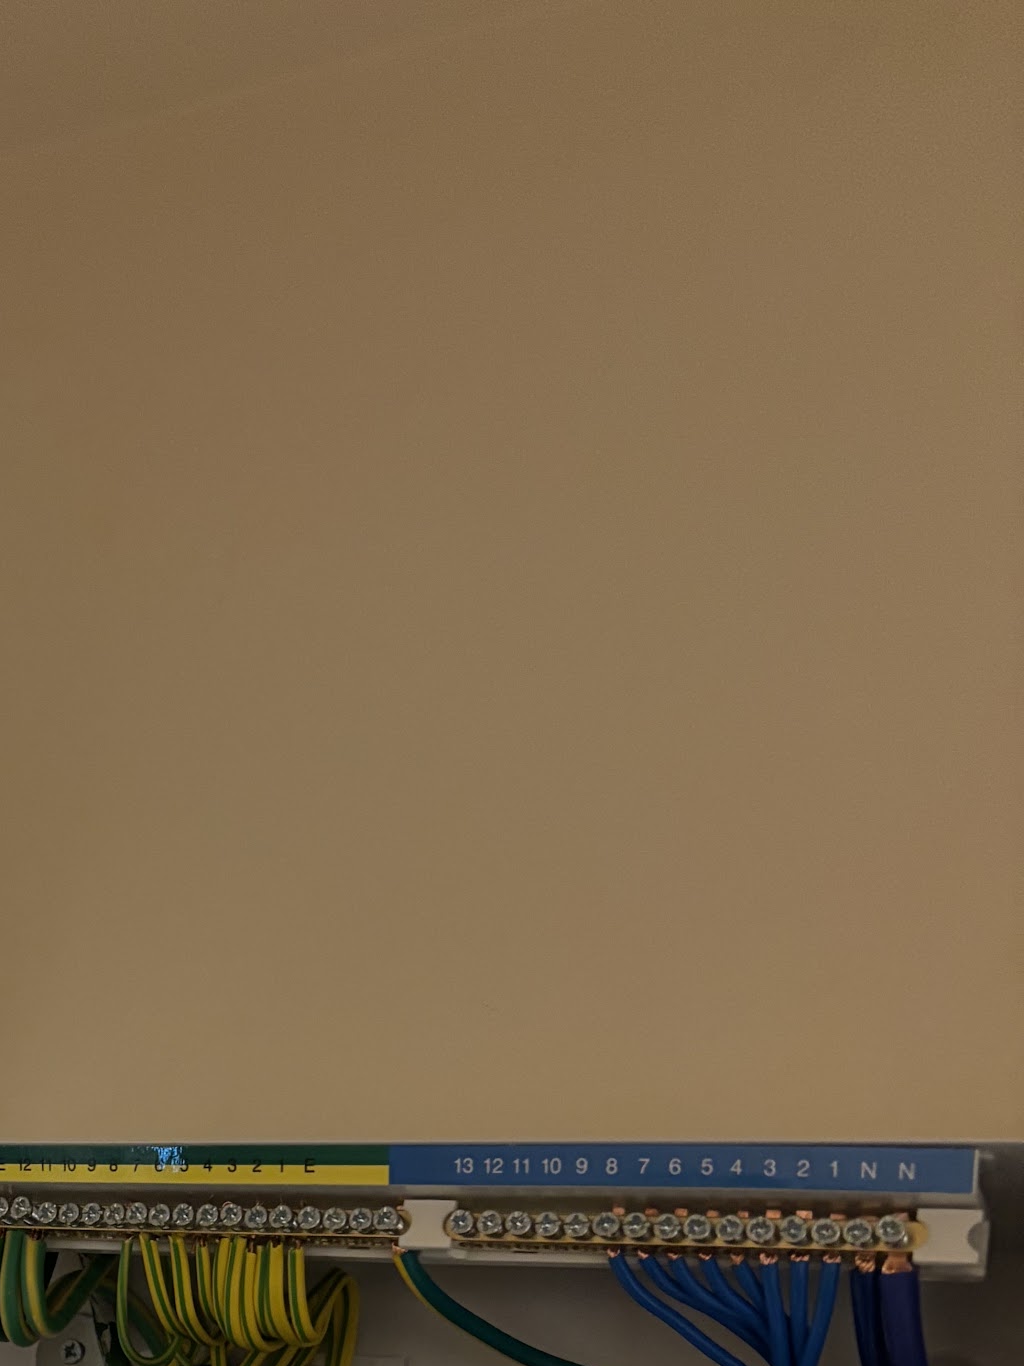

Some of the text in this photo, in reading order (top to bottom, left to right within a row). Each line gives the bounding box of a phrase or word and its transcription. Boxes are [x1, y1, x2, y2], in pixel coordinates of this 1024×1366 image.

[20, 1159, 315, 1173] 12 11 10 2 E
[454, 1157, 916, 1180] 13 12 11 10 9 8 7 6 5 4 3 2 1 N N
